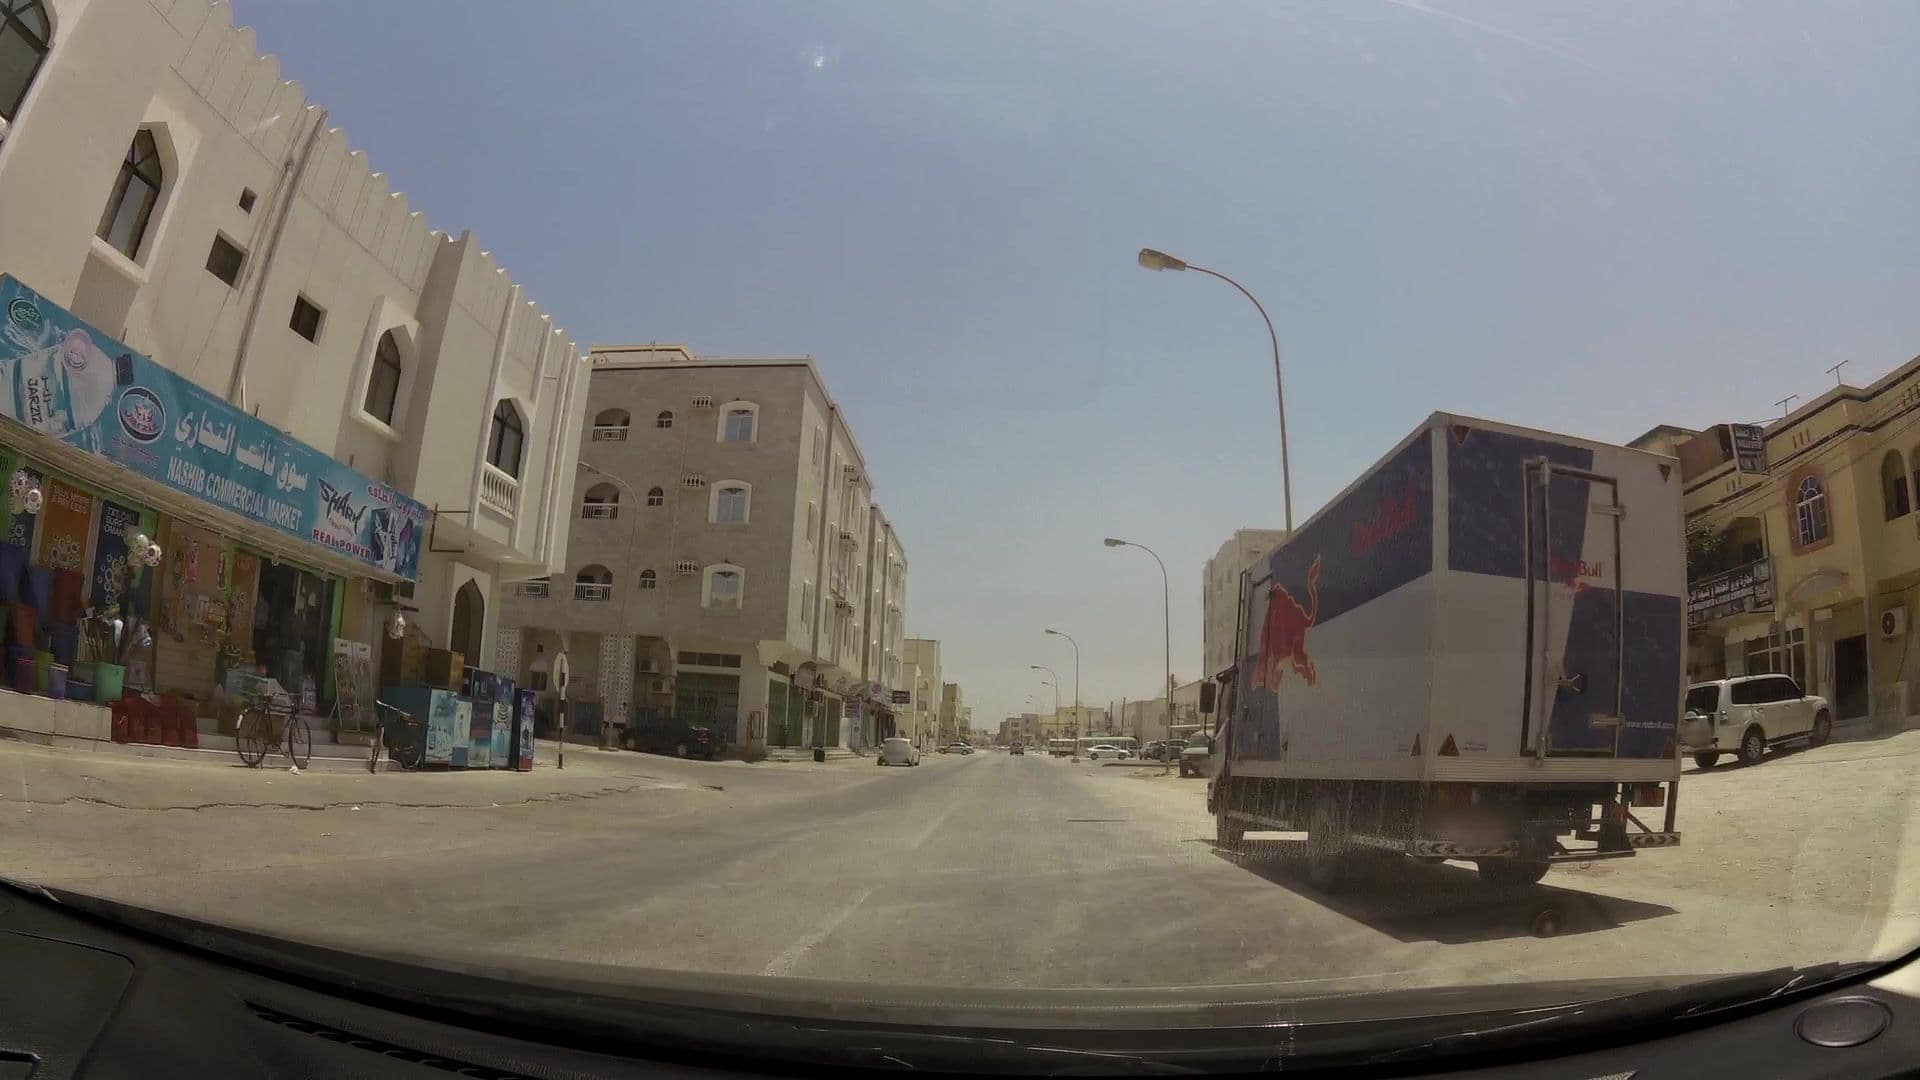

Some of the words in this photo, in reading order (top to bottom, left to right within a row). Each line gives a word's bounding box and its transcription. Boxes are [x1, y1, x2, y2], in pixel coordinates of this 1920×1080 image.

[174, 410, 237, 456] التجاري
[167, 455, 206, 493] NASHIB
[206, 472, 264, 517] COMMERCIAL
[265, 496, 303, 531] MARKET
[276, 452, 308, 493] سوق
[312, 529, 338, 547] REAL
